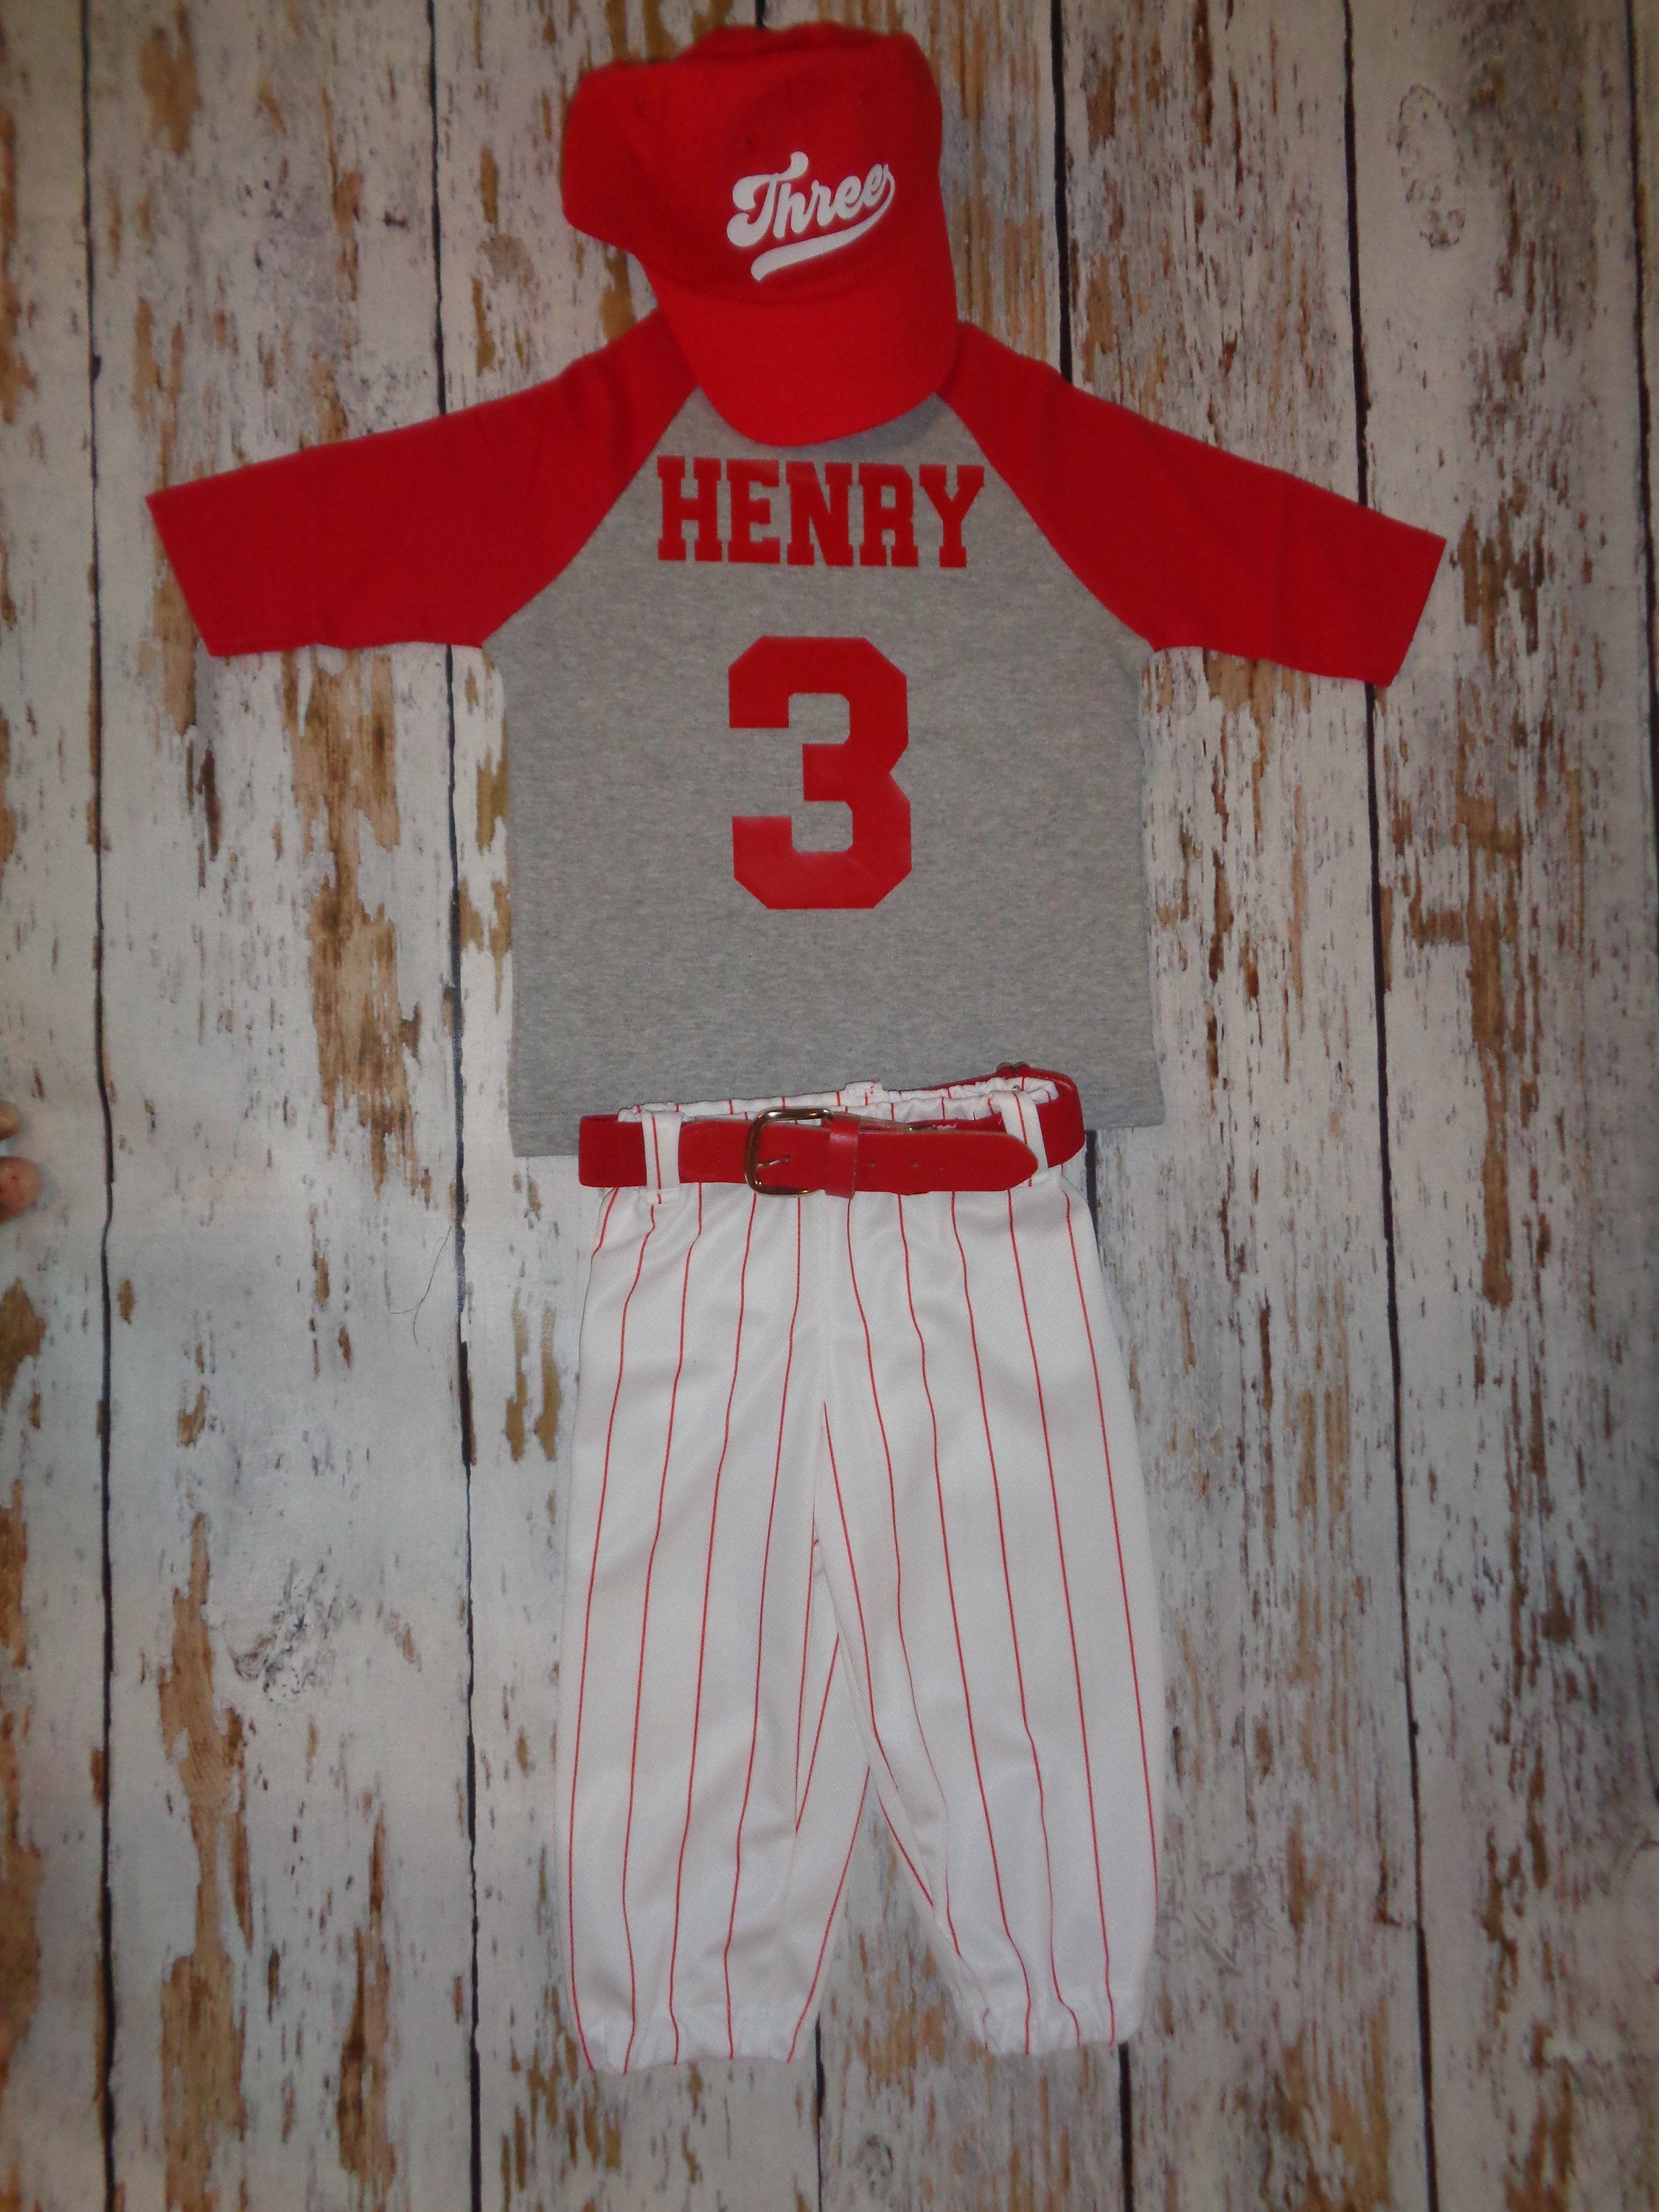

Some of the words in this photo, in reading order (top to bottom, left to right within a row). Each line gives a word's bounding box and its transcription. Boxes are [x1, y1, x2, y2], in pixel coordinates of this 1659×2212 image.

[726, 151, 894, 246] Three
[658, 456, 984, 568] HENRY
[728, 636, 912, 909] 3
